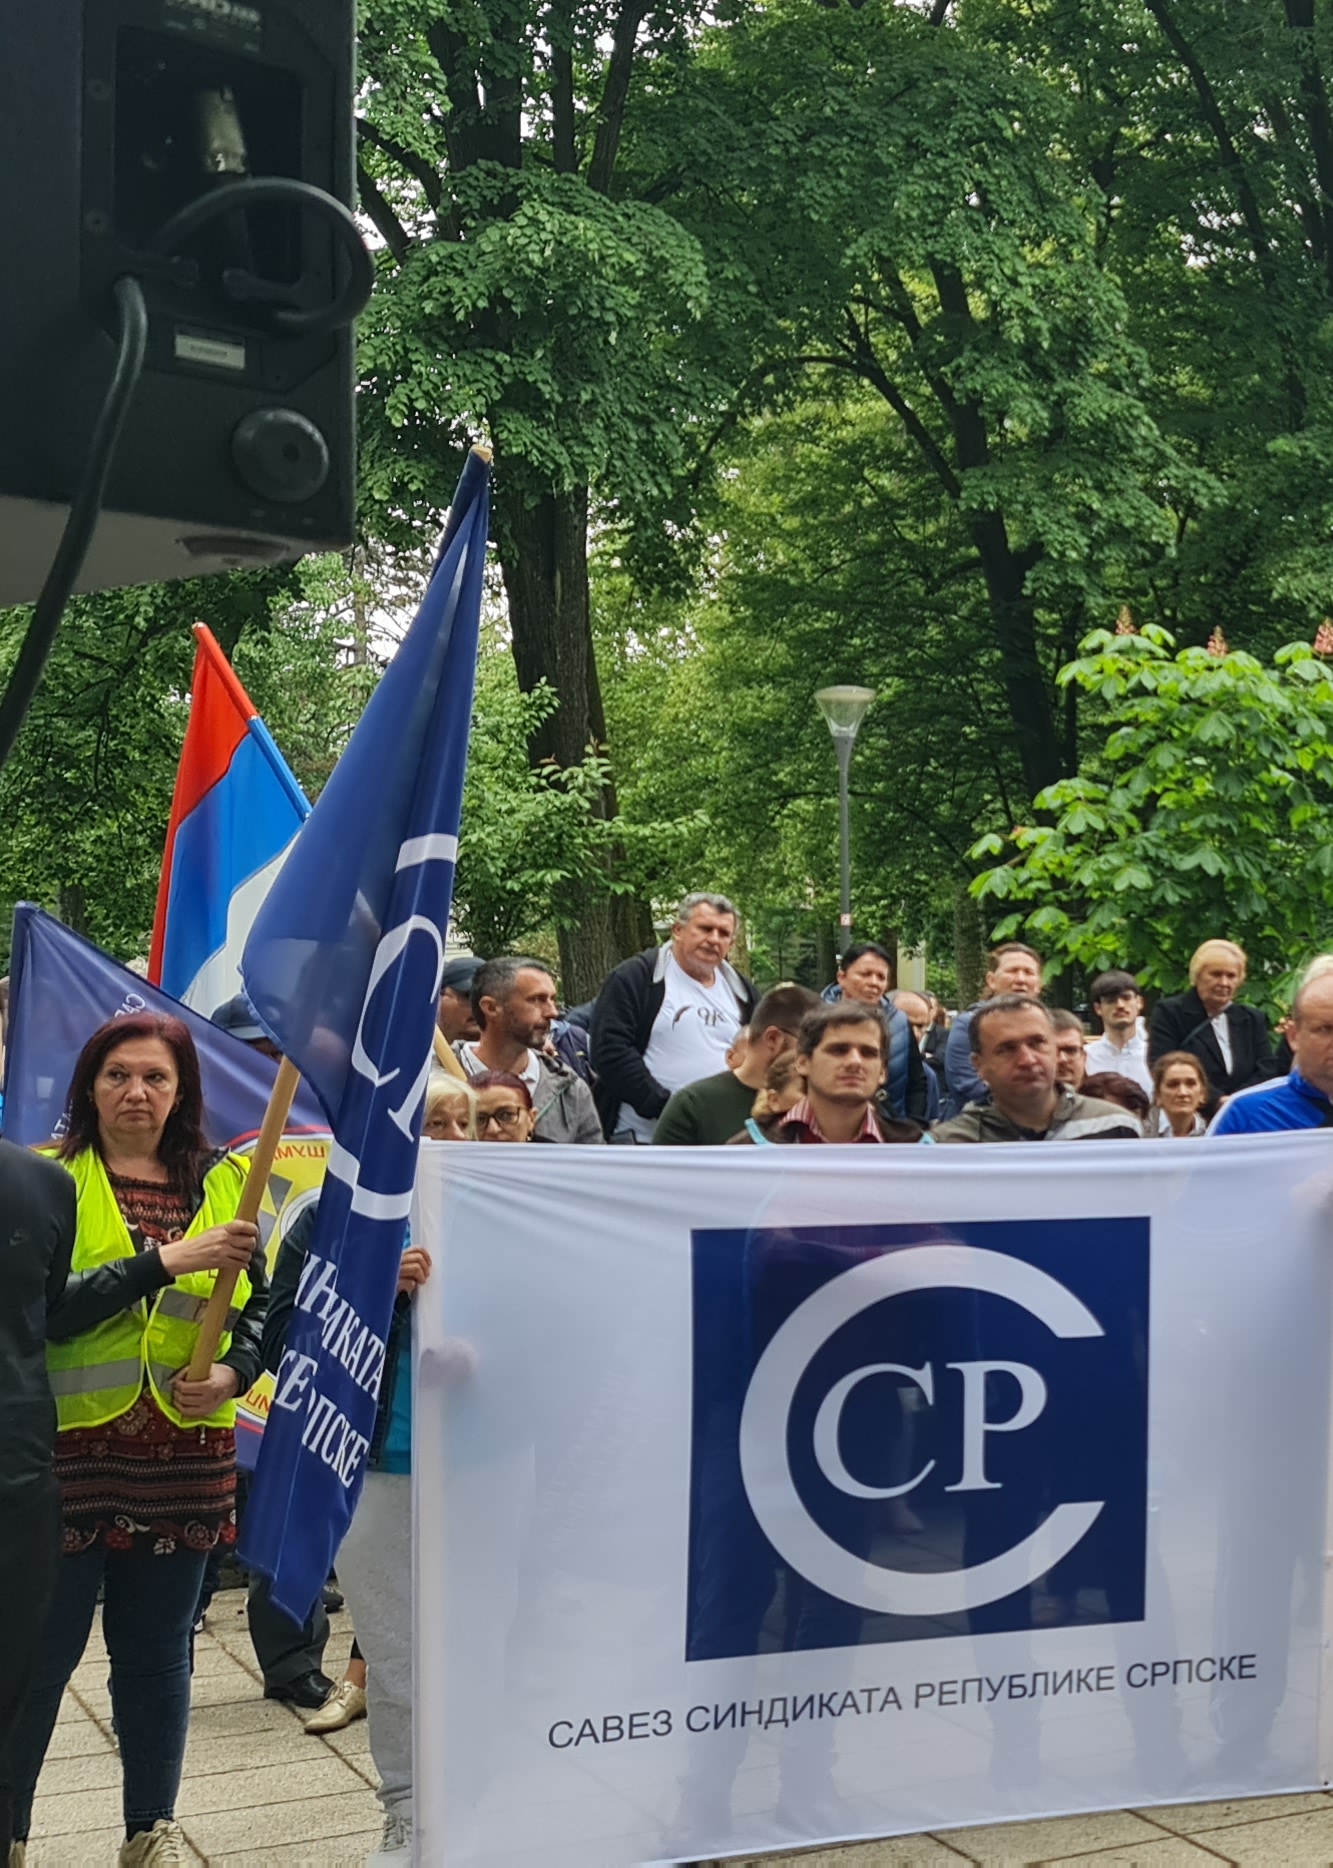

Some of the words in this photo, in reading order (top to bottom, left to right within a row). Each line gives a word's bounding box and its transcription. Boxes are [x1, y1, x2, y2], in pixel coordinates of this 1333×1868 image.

[548, 1709, 673, 1750] САВЕЗ
[685, 1686, 903, 1734] СИНДИКАТА
[914, 1665, 1115, 1710] РЕПУБЛИКЕ
[1126, 1653, 1258, 1690] СРПСКЕ
